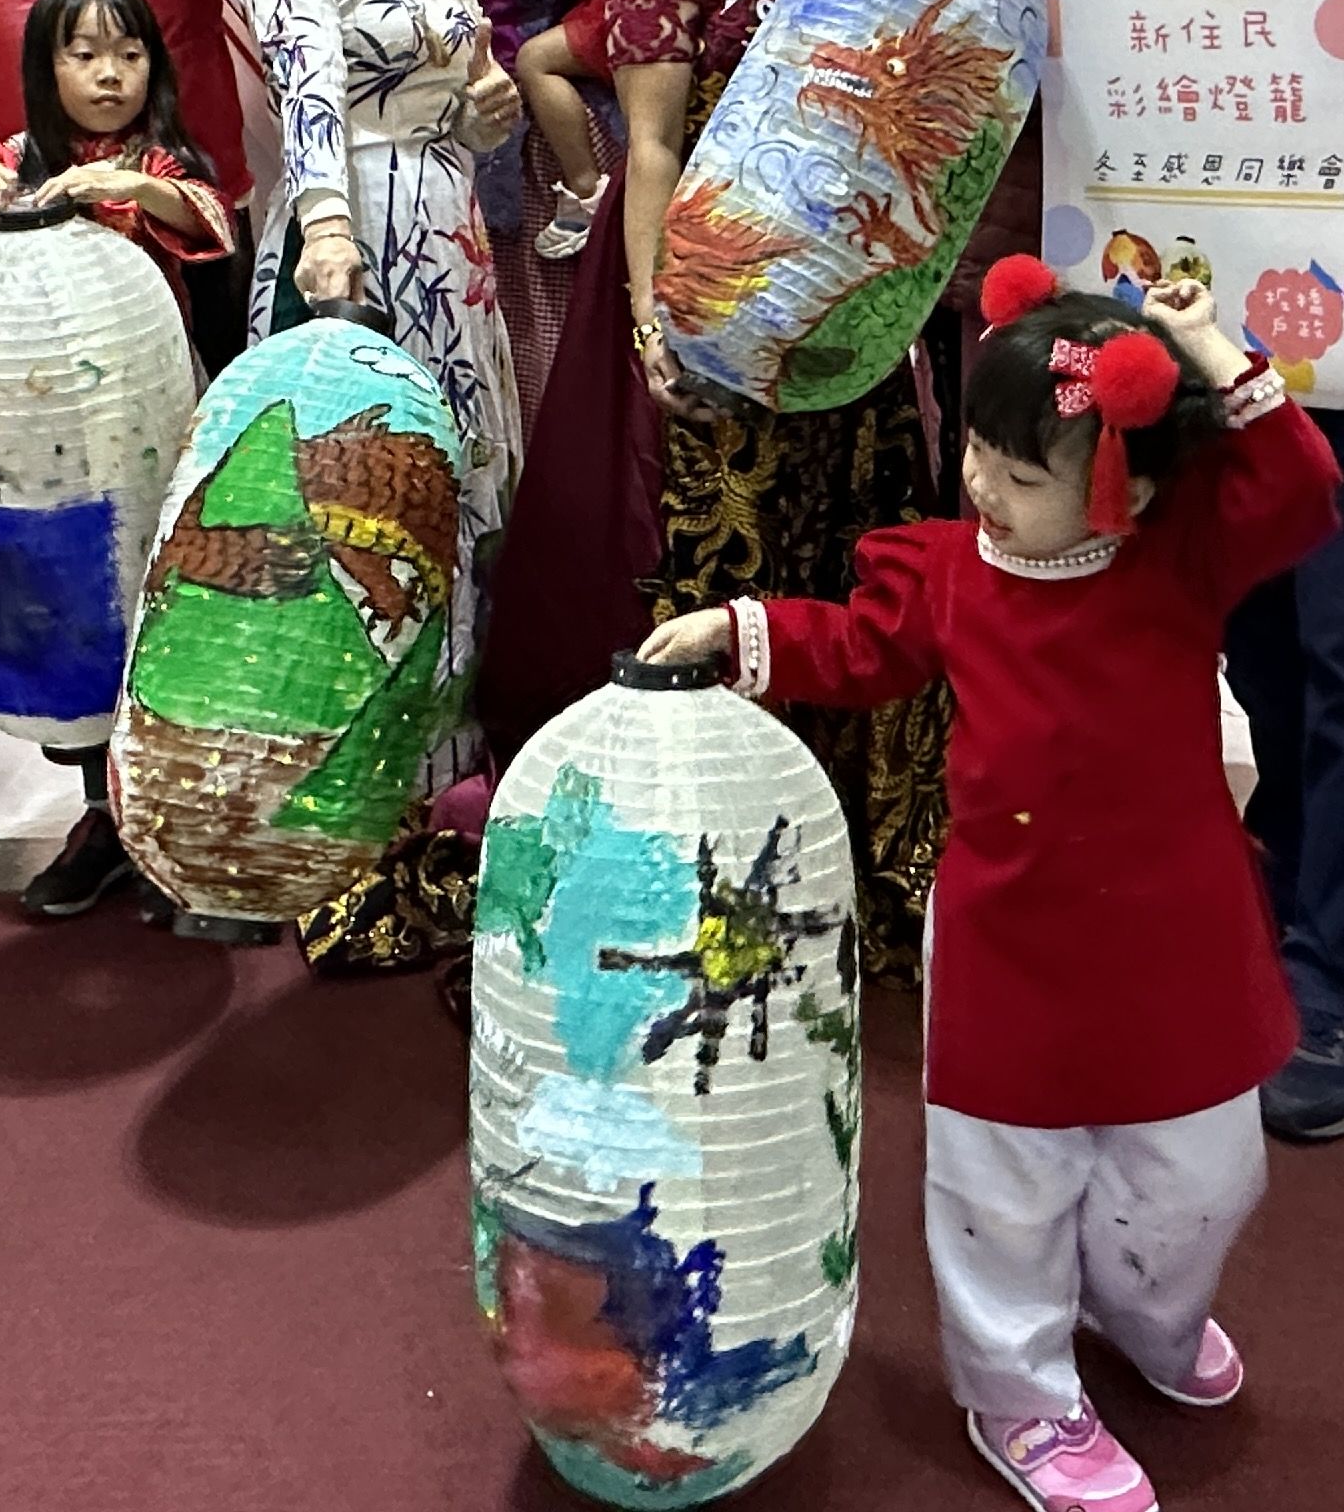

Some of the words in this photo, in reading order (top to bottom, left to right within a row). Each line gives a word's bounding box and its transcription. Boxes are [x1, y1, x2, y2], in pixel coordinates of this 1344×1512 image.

[1128, 10, 1277, 53] 新住民
[1106, 72, 1308, 124] 彩繪燈籠
[1093, 149, 1344, 190] 冬至感恩同樂會
